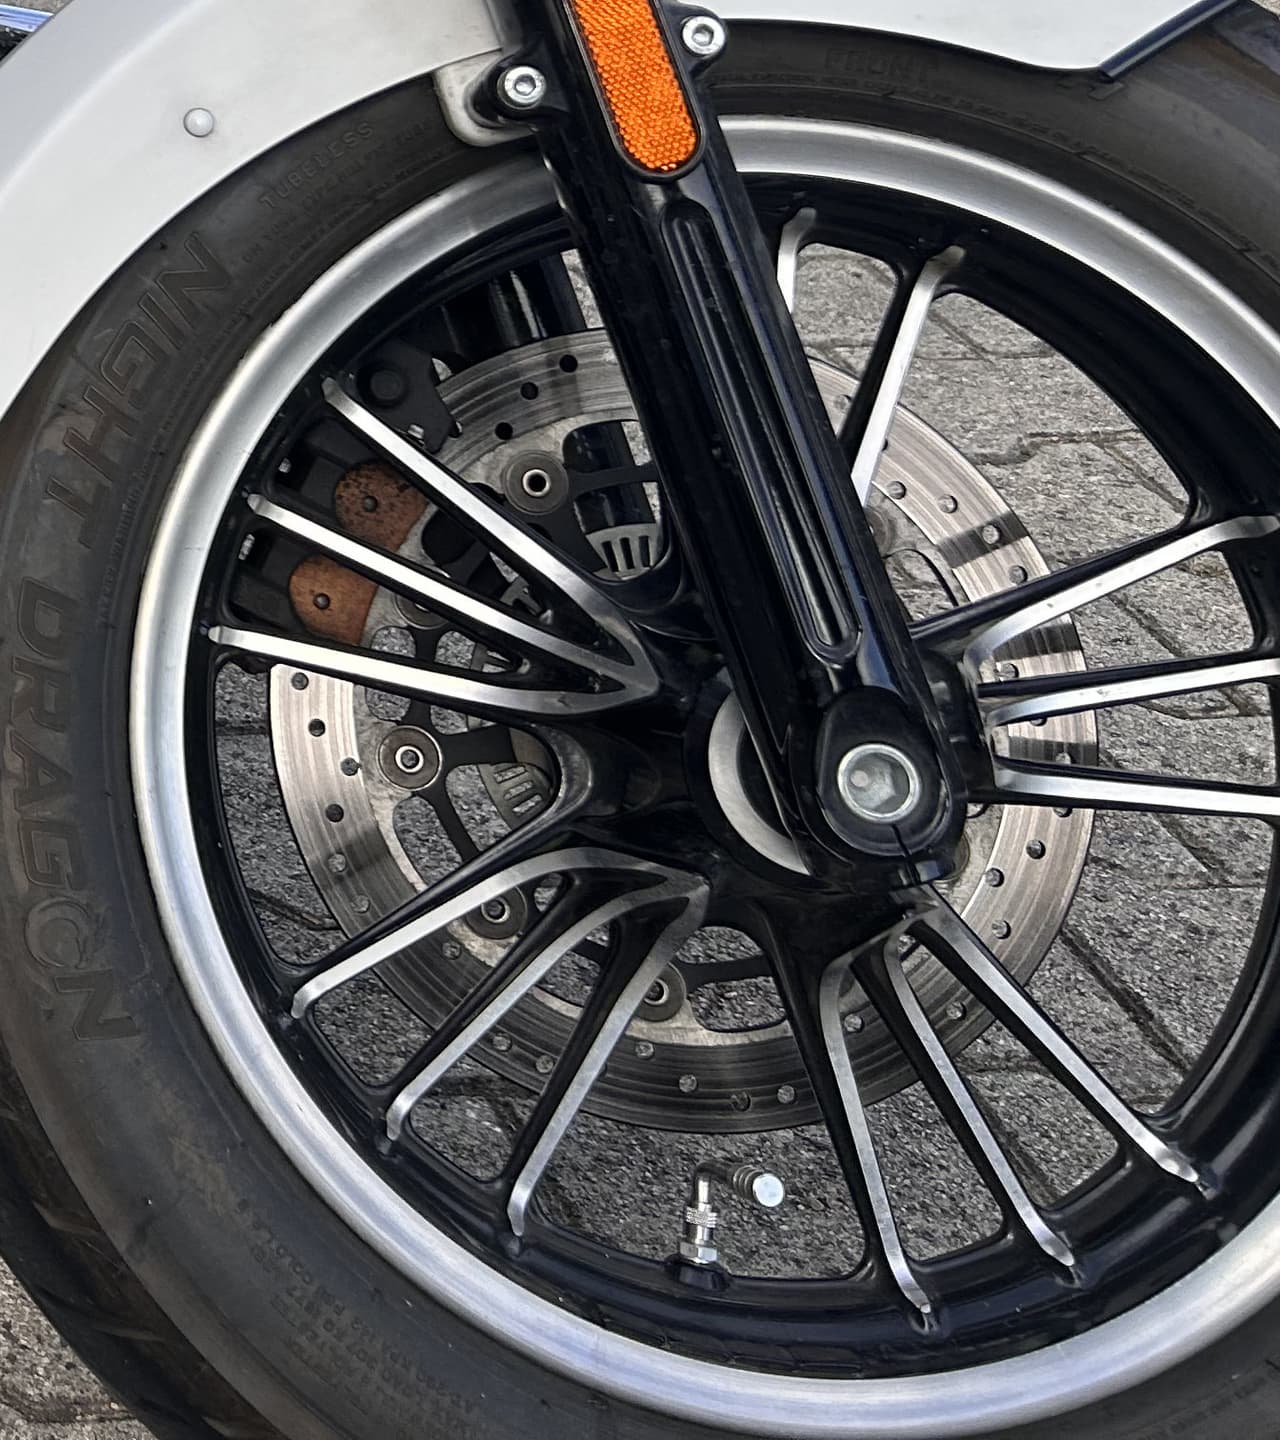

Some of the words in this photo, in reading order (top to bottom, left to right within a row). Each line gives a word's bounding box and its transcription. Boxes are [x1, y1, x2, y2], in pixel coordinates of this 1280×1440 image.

[258, 122, 374, 209] TUBELESS
[46, 231, 233, 552] NIGHT
[8, 575, 141, 1042] DRAGON
